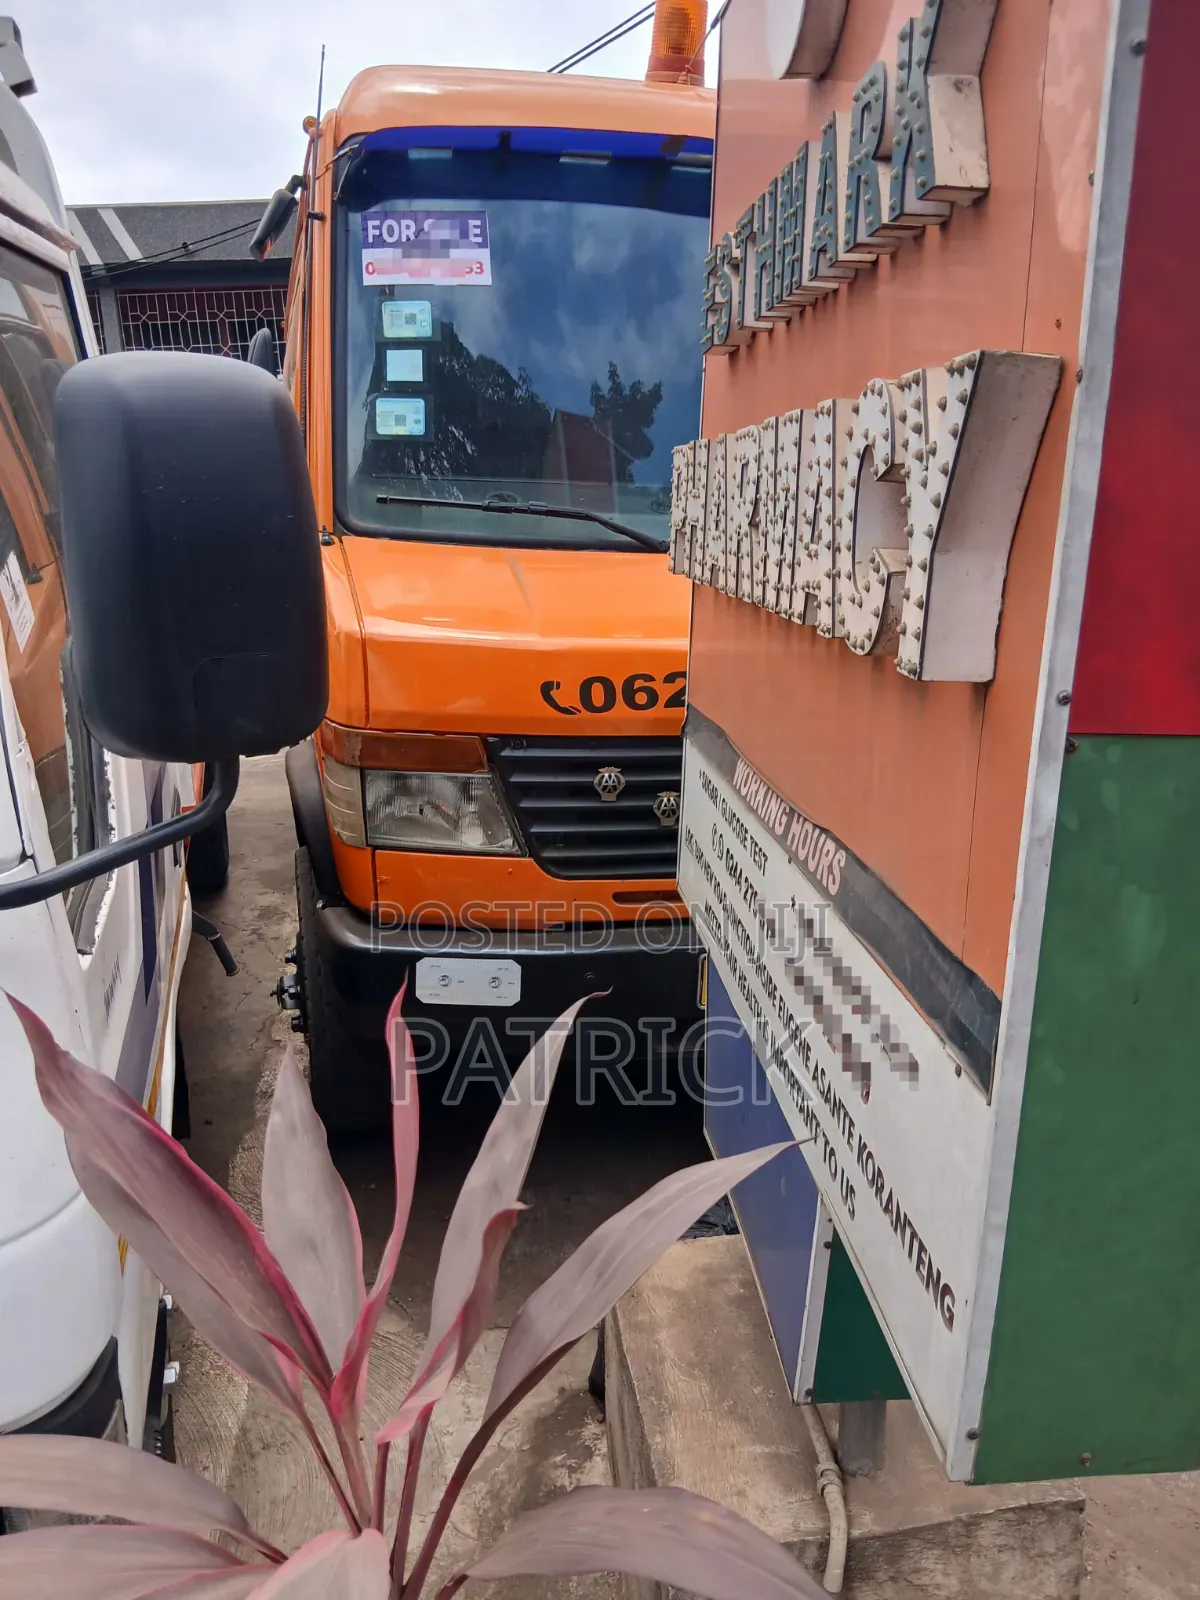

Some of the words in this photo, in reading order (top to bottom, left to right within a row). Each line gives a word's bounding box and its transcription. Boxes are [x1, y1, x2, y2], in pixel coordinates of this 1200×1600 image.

[367, 218, 416, 244] FOR
[668, 350, 990, 683] PHARMACY
[578, 670, 687, 714] 062
[701, 770, 719, 809] SUGAR
[721, 797, 749, 852] GLUCOSE
[749, 834, 769, 877] TEST
[725, 847, 743, 895] 0244
[732, 757, 790, 836] WORKING
[786, 812, 846, 896] HOURS
[722, 934, 738, 982] YOUR
[737, 964, 763, 1032] HEALTH
[769, 1029, 821, 1147] IMPORTANT
[821, 1129, 838, 1183] TO
[839, 1166, 856, 1221] US
[777, 992, 812, 1075] EUGENE
[811, 1057, 856, 1156] ASANTE
[856, 1132, 956, 1334] KORANTENG
